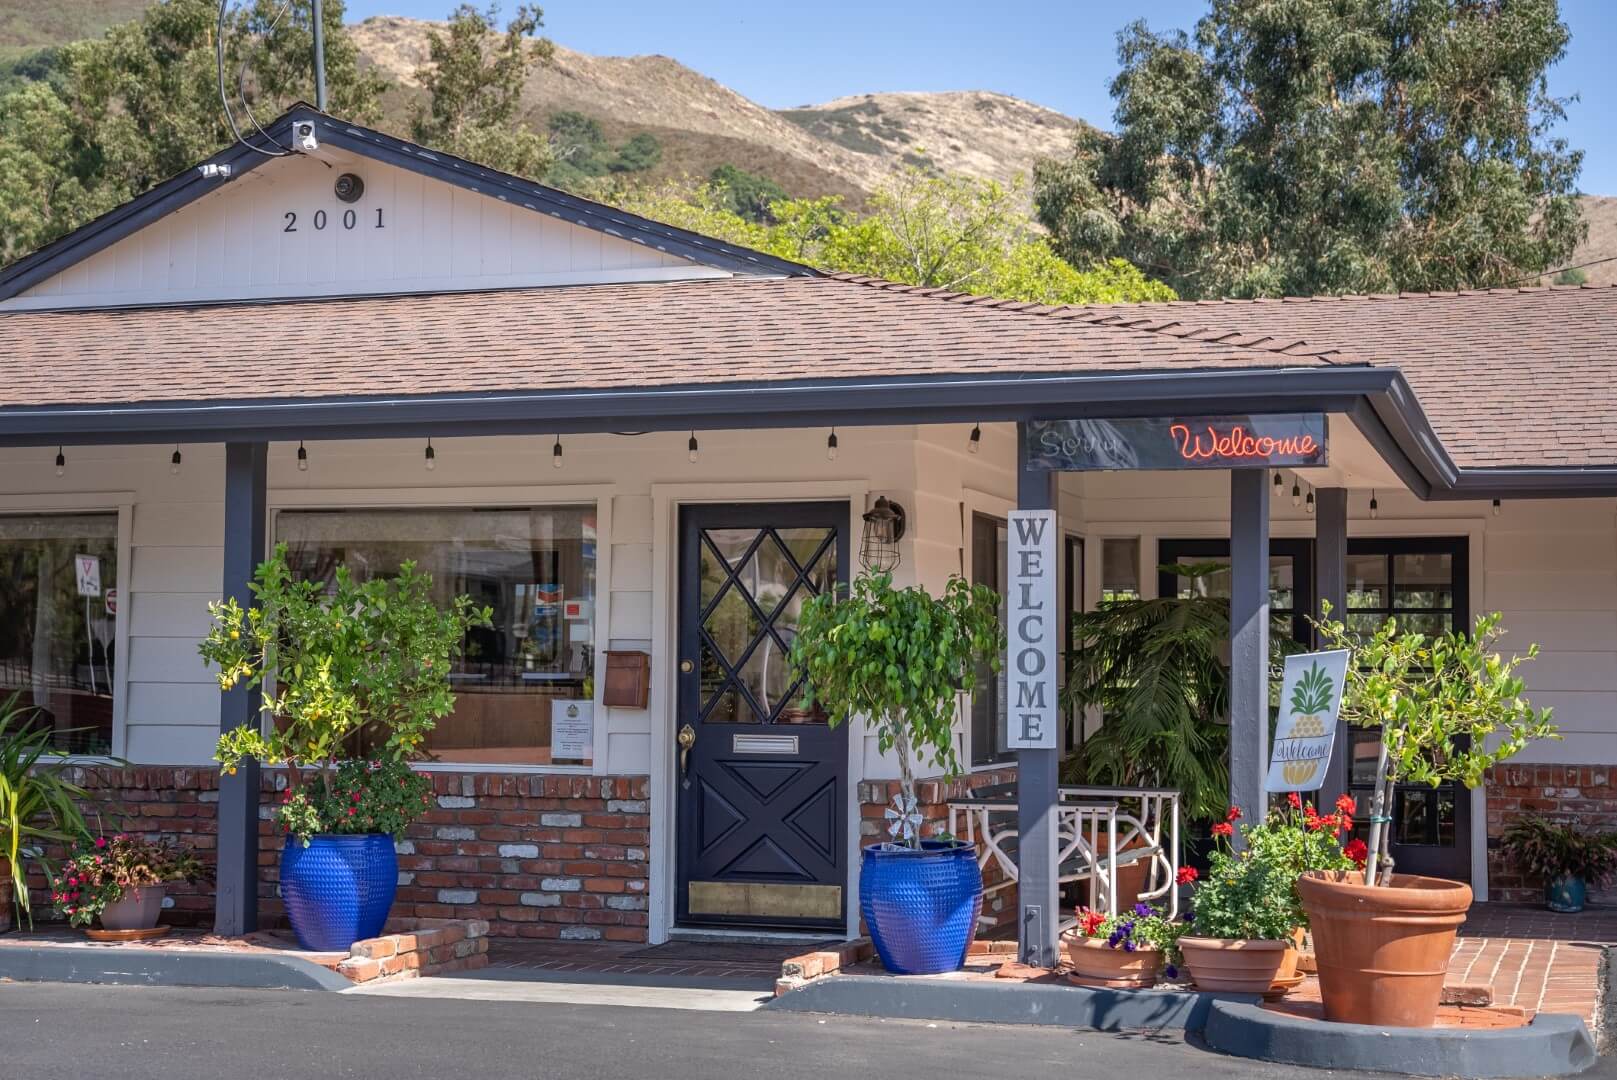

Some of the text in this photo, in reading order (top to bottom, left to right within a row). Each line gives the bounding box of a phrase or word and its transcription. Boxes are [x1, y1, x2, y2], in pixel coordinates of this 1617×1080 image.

[284, 208, 385, 232] 2001
[1170, 424, 1318, 458] Welcome
[1012, 518, 1049, 741] WELCOME
[1276, 740, 1329, 759] Welcome
